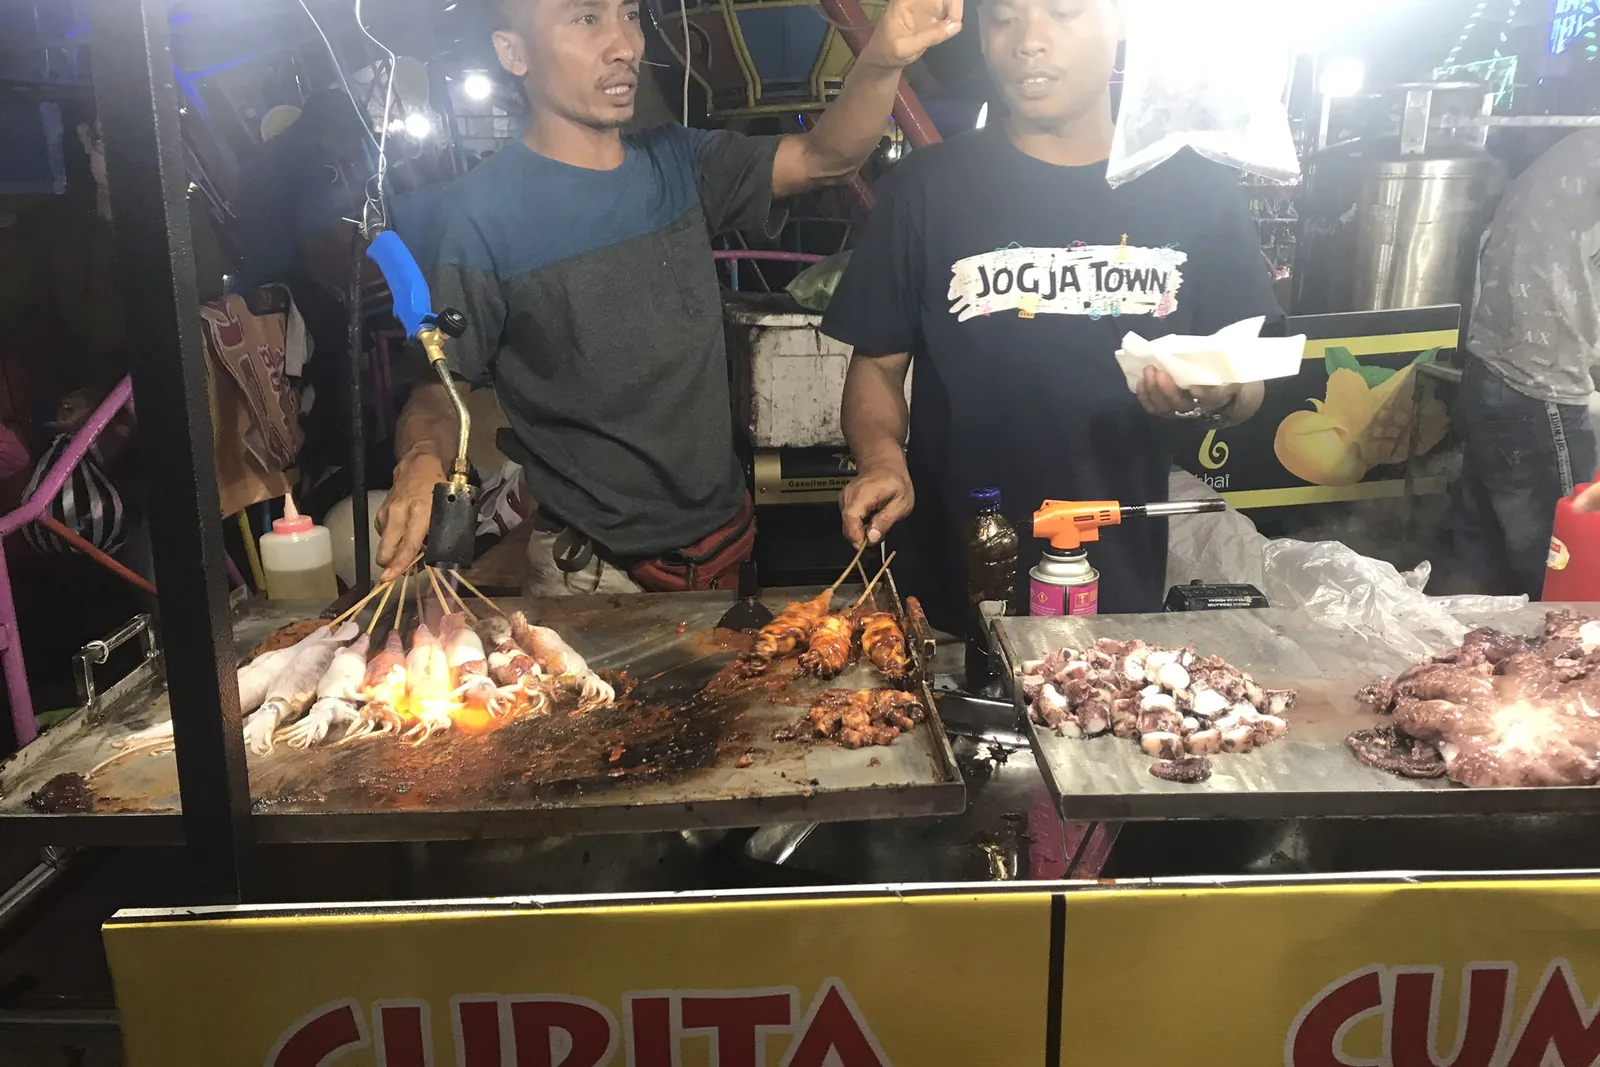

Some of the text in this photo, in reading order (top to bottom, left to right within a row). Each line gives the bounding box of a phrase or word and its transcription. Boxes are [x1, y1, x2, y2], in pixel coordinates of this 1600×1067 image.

[976, 260, 1168, 301] JOGJA TOWN
[788, 479, 828, 488] Gasoline
